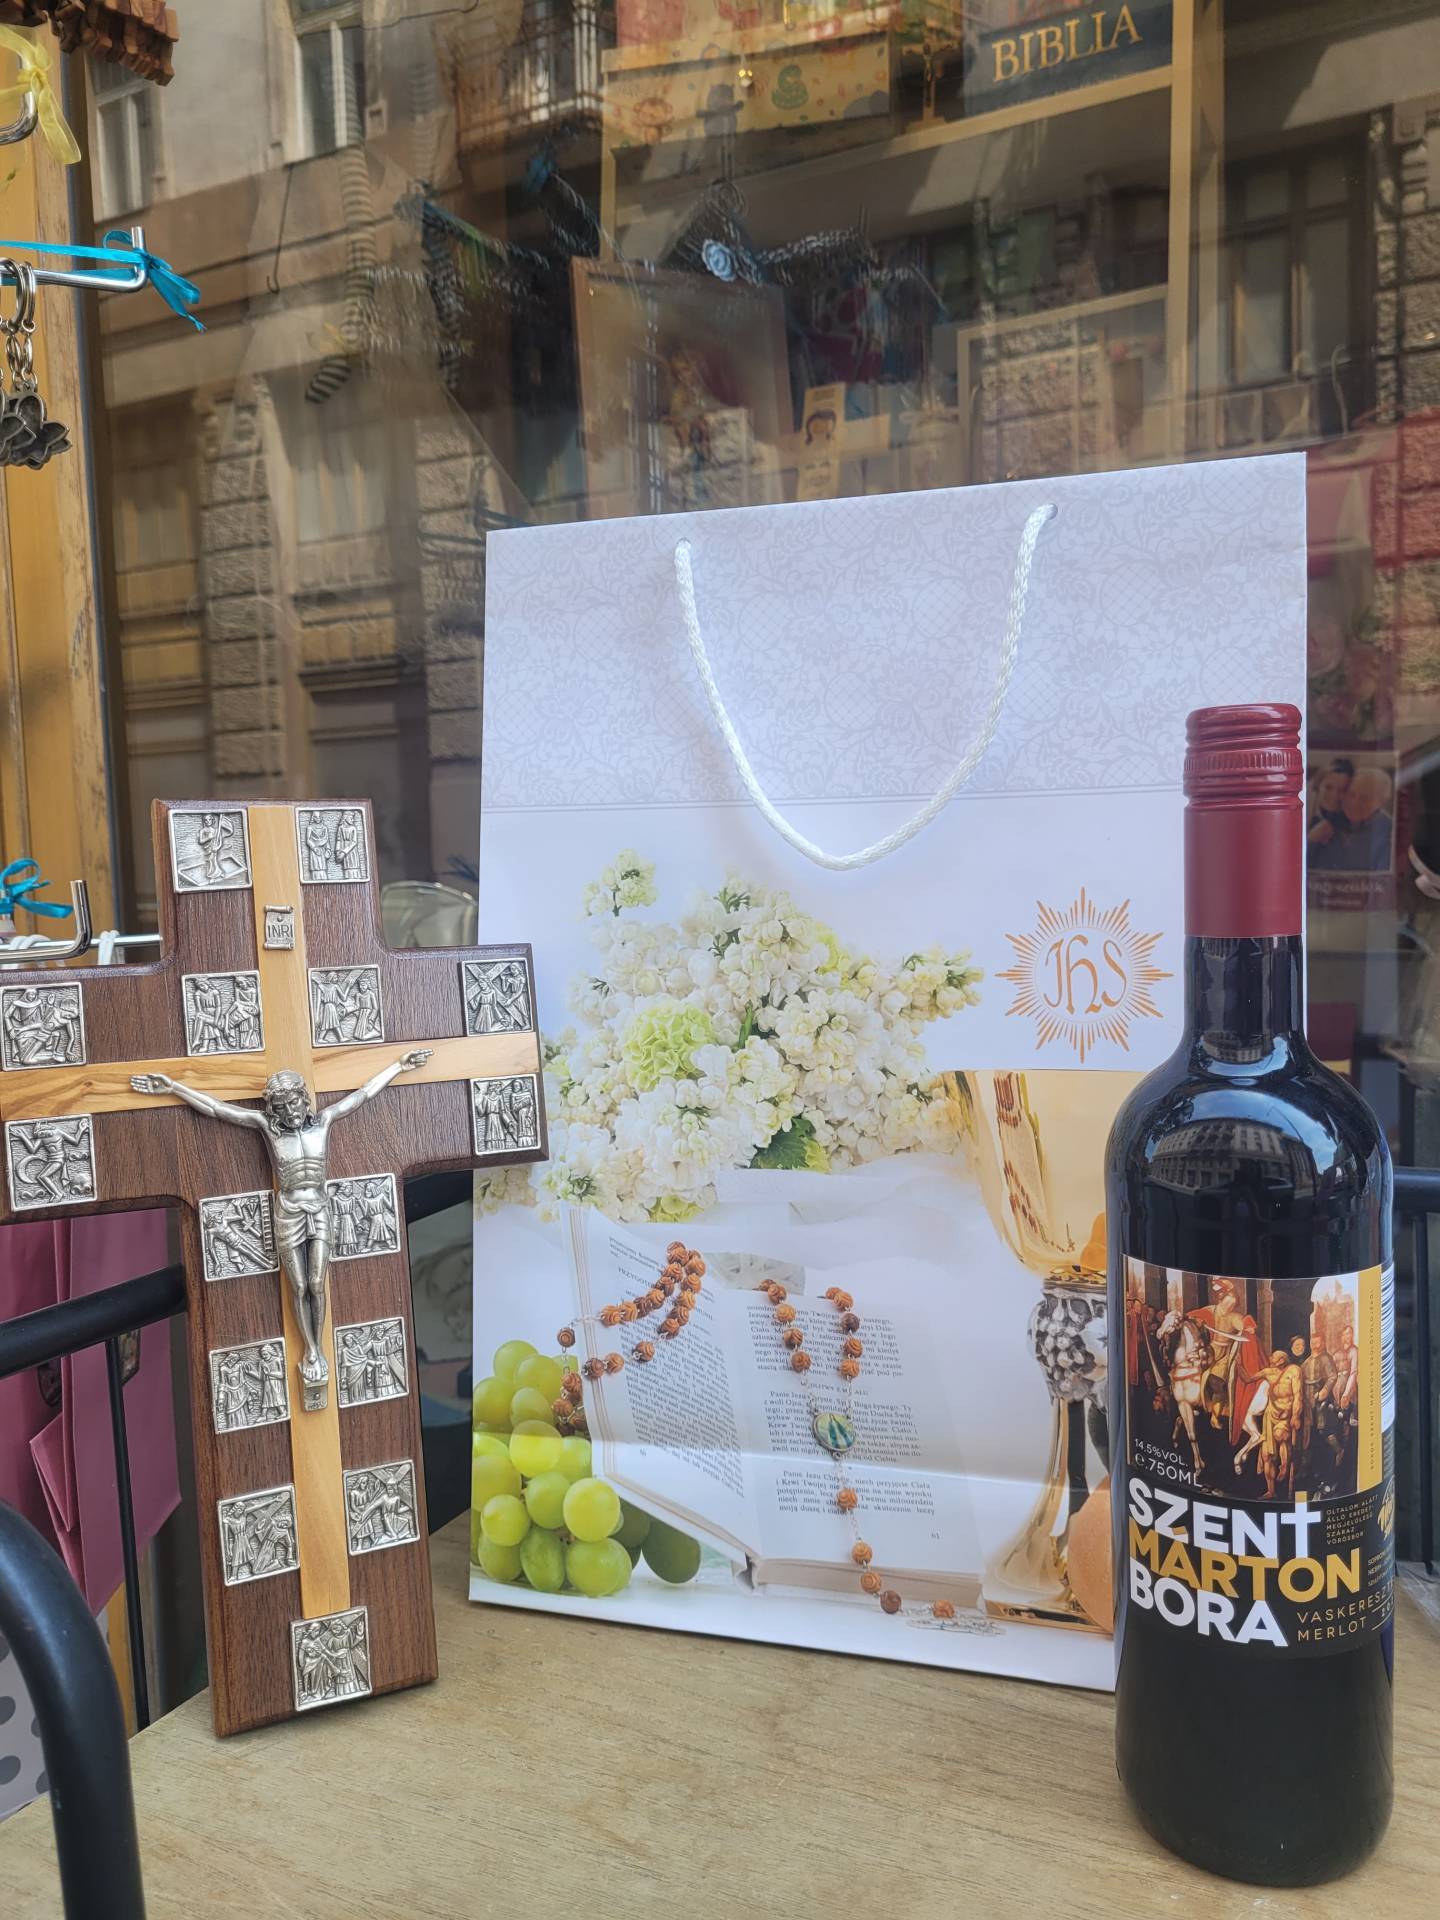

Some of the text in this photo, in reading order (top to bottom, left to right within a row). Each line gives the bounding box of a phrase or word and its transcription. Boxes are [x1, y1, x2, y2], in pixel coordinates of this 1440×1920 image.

[991, 4, 1143, 82] BIBLIA
[267, 924, 294, 938] INRI
[1134, 1438, 1190, 1468] 14.5%VOL.
[1128, 1516, 1361, 1603] MÁRTON
[1129, 1556, 1289, 1647] BORA
[1297, 1616, 1367, 1641] MERLOT
